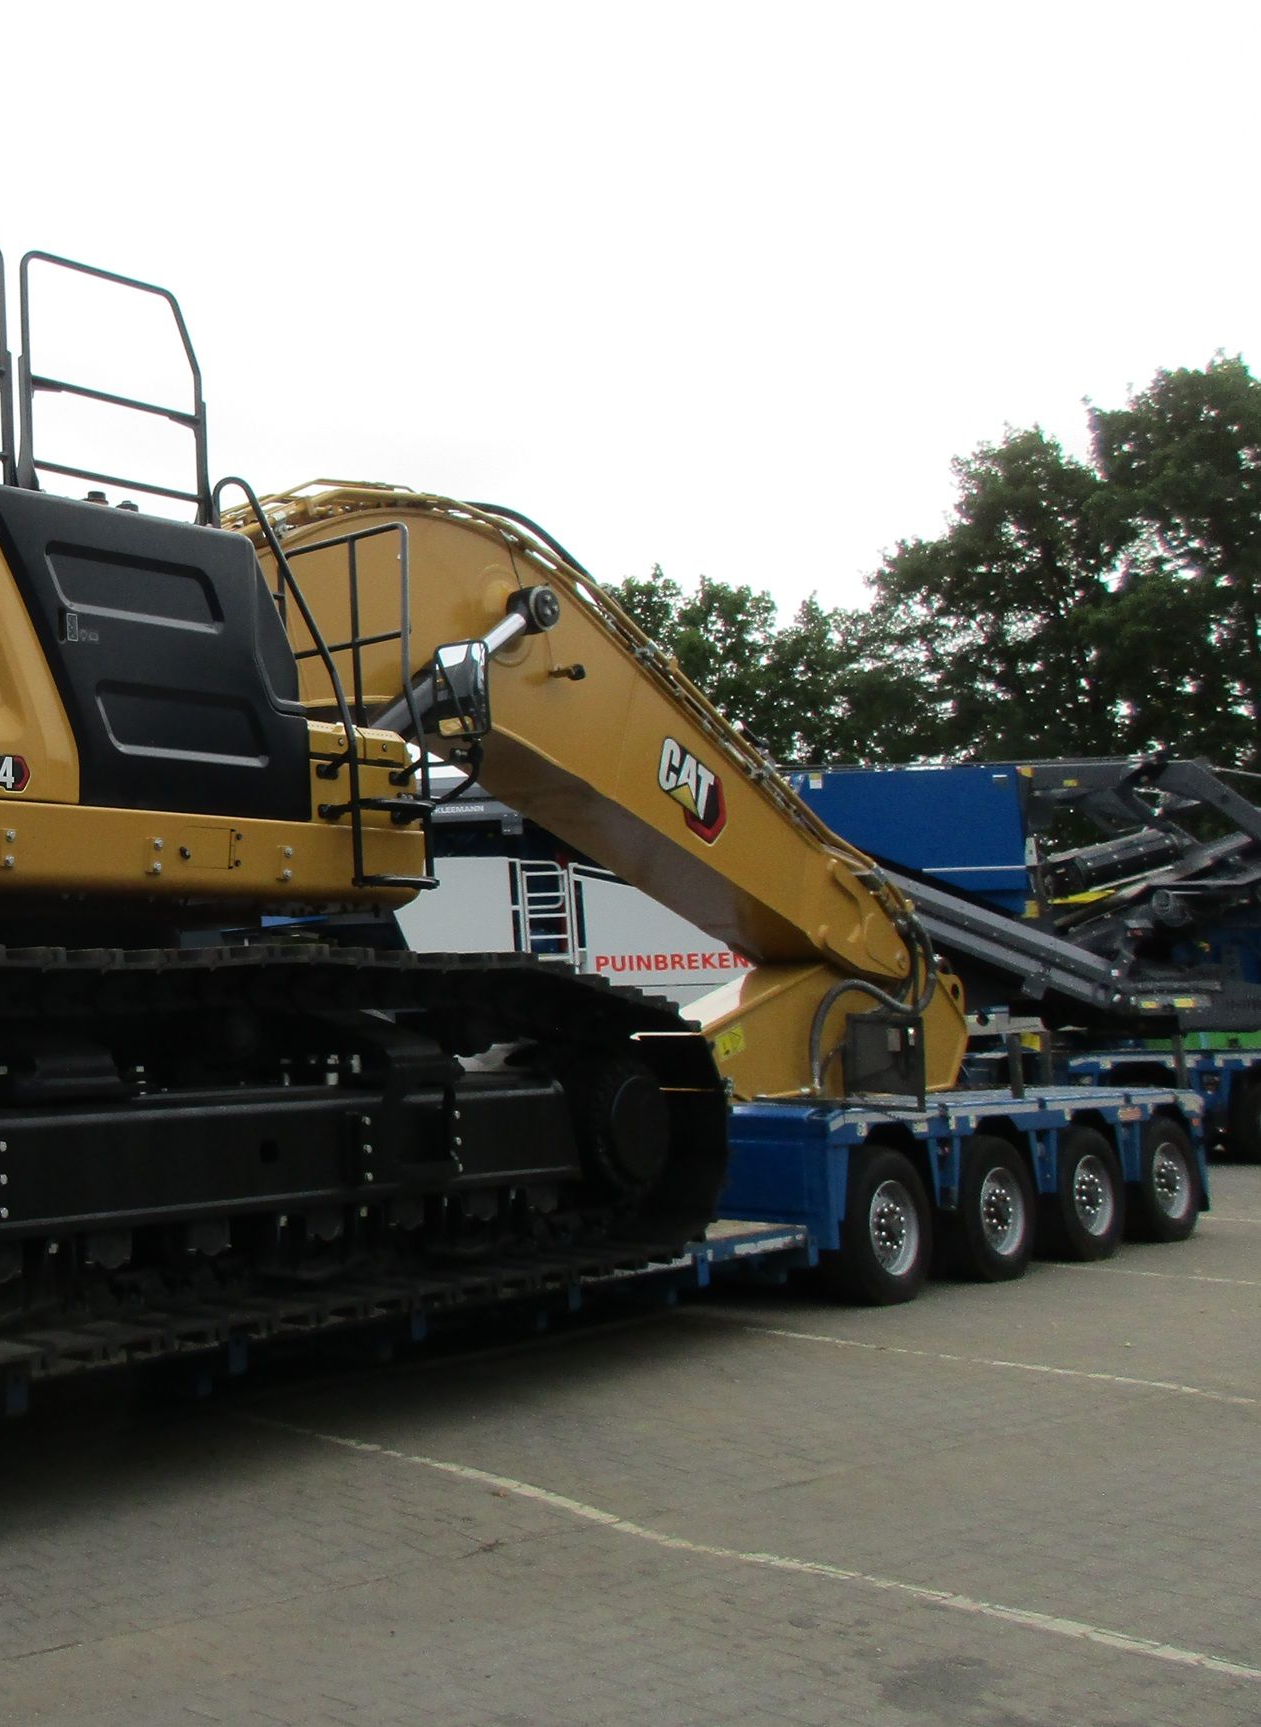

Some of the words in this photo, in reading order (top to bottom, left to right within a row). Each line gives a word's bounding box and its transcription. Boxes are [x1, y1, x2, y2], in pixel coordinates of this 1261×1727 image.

[658, 738, 716, 821] CAT
[435, 805, 484, 814] KLEEMANN
[595, 952, 749, 973] PUINBREKEN
